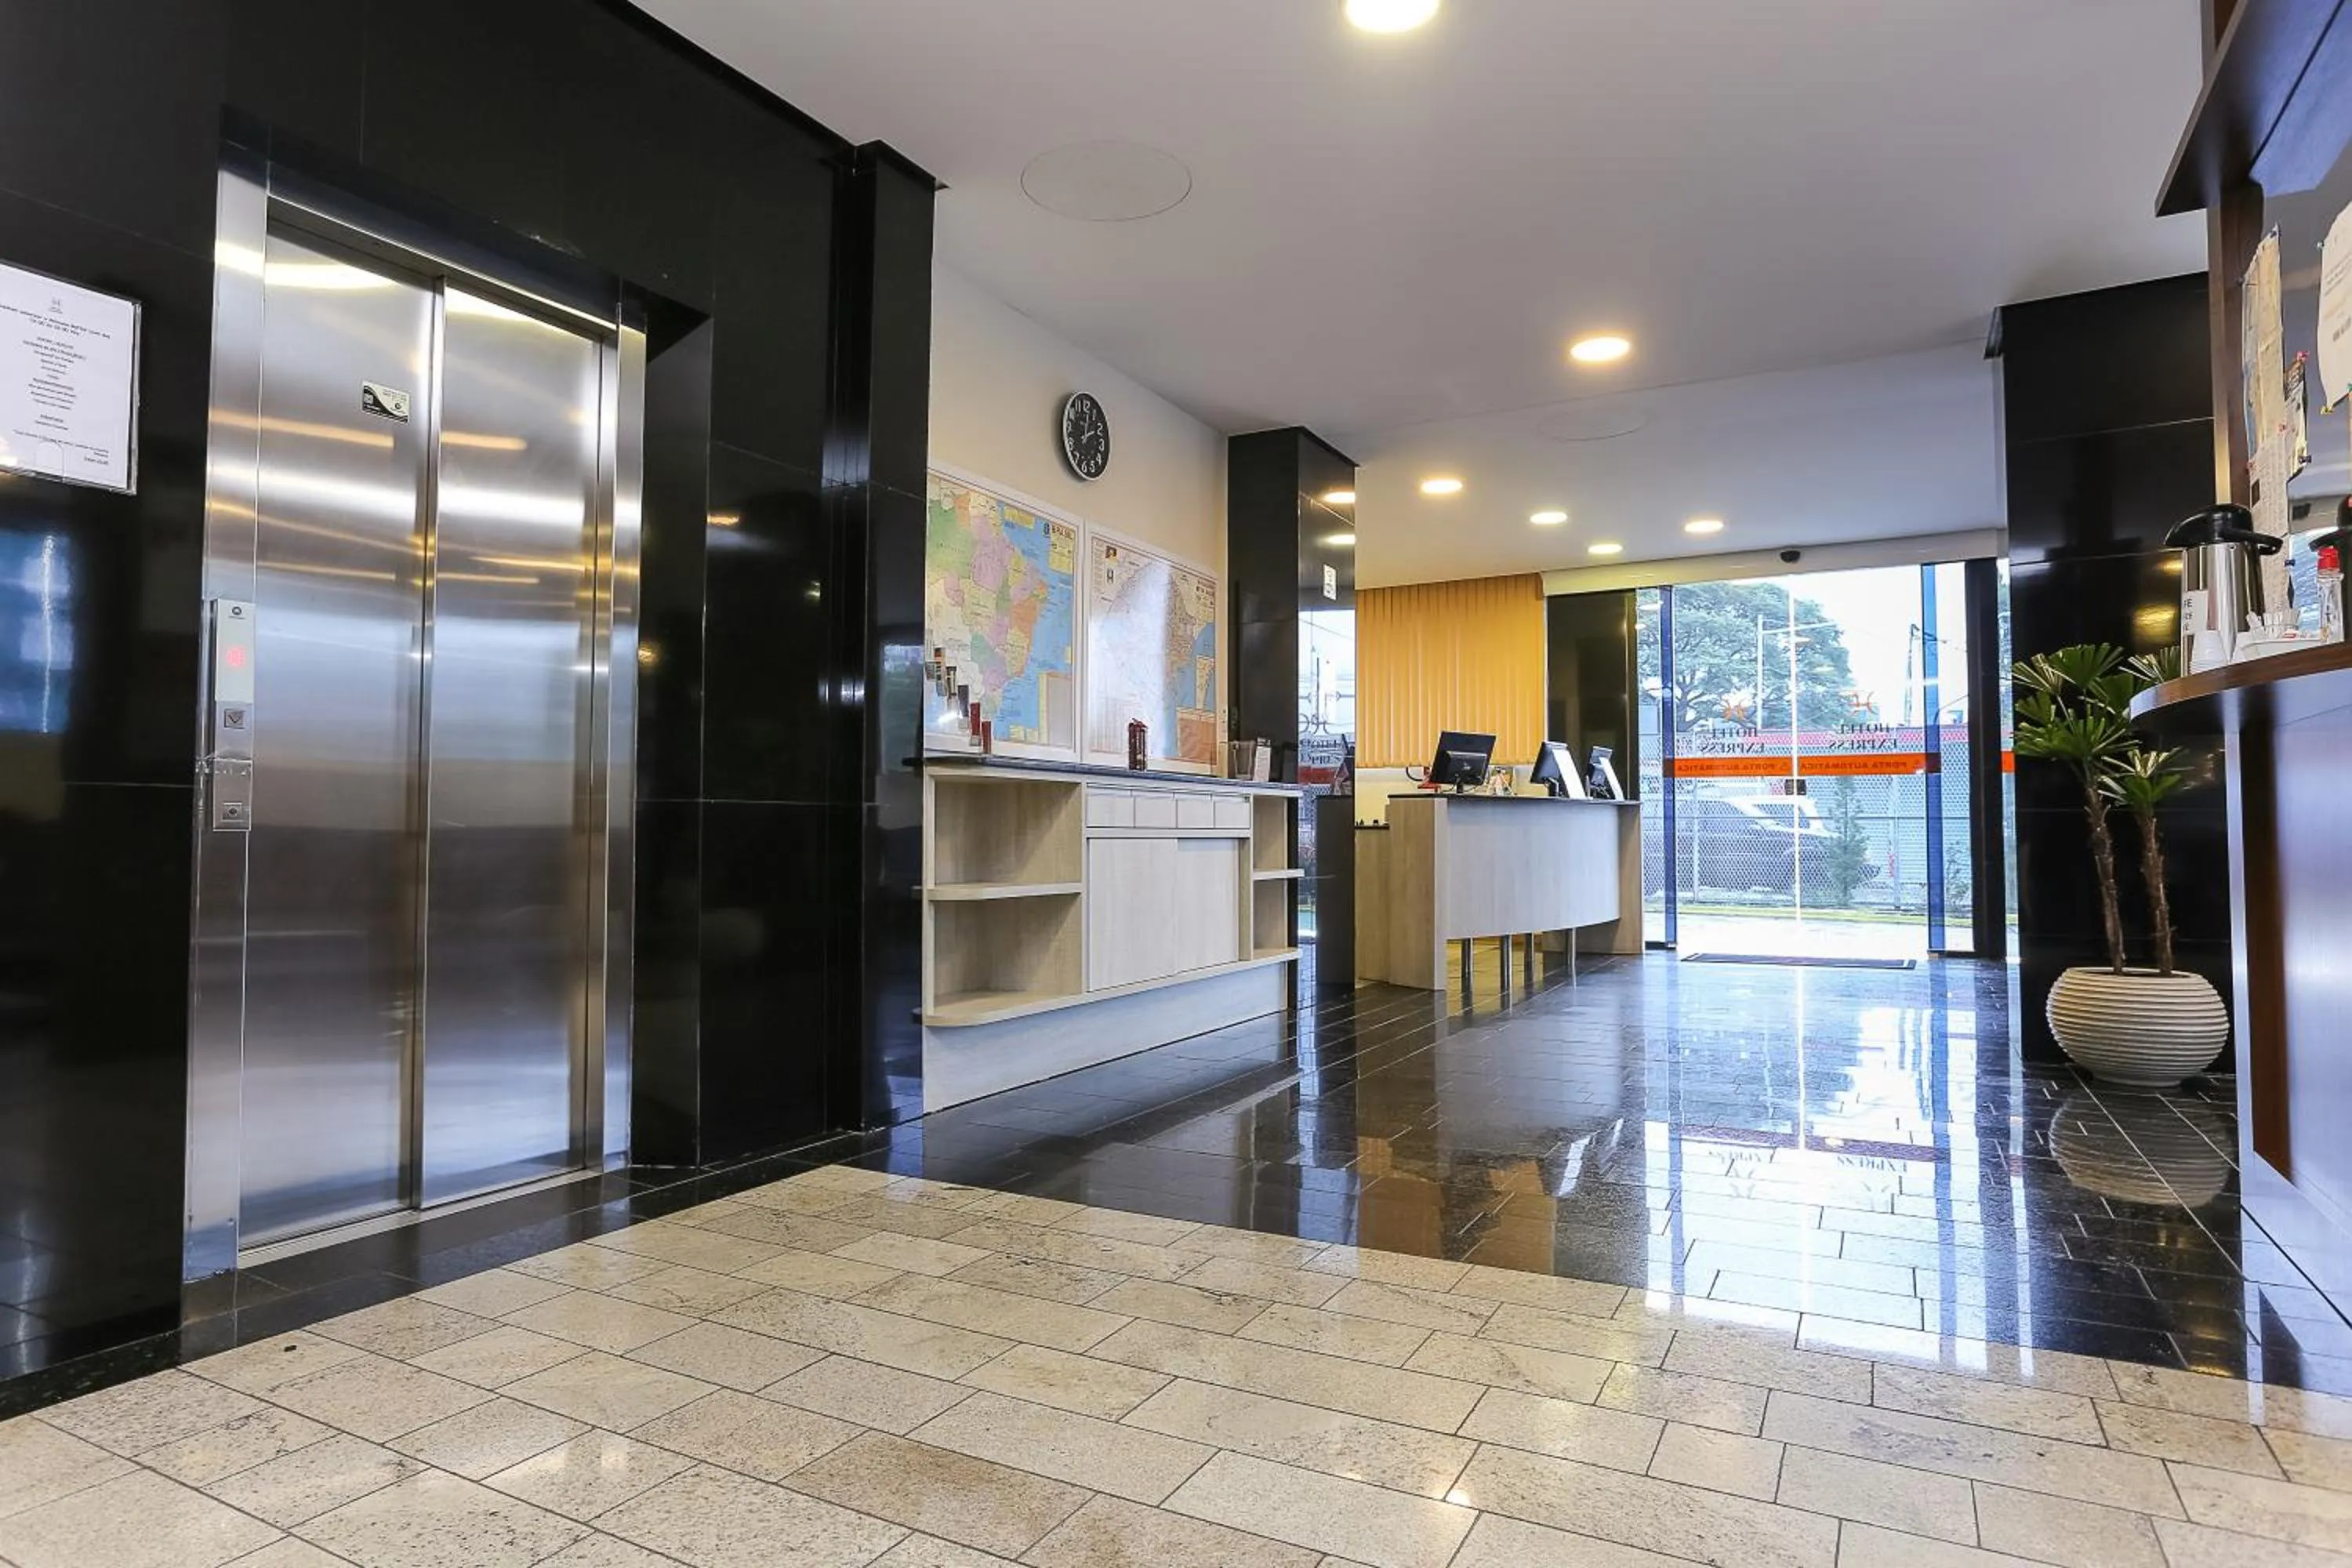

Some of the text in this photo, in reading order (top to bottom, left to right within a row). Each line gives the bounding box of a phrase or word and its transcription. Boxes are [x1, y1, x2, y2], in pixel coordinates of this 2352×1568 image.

[1097, 423, 1103, 437] 2
[1098, 438, 1105, 452] 3
[1081, 460, 1087, 473] 6
